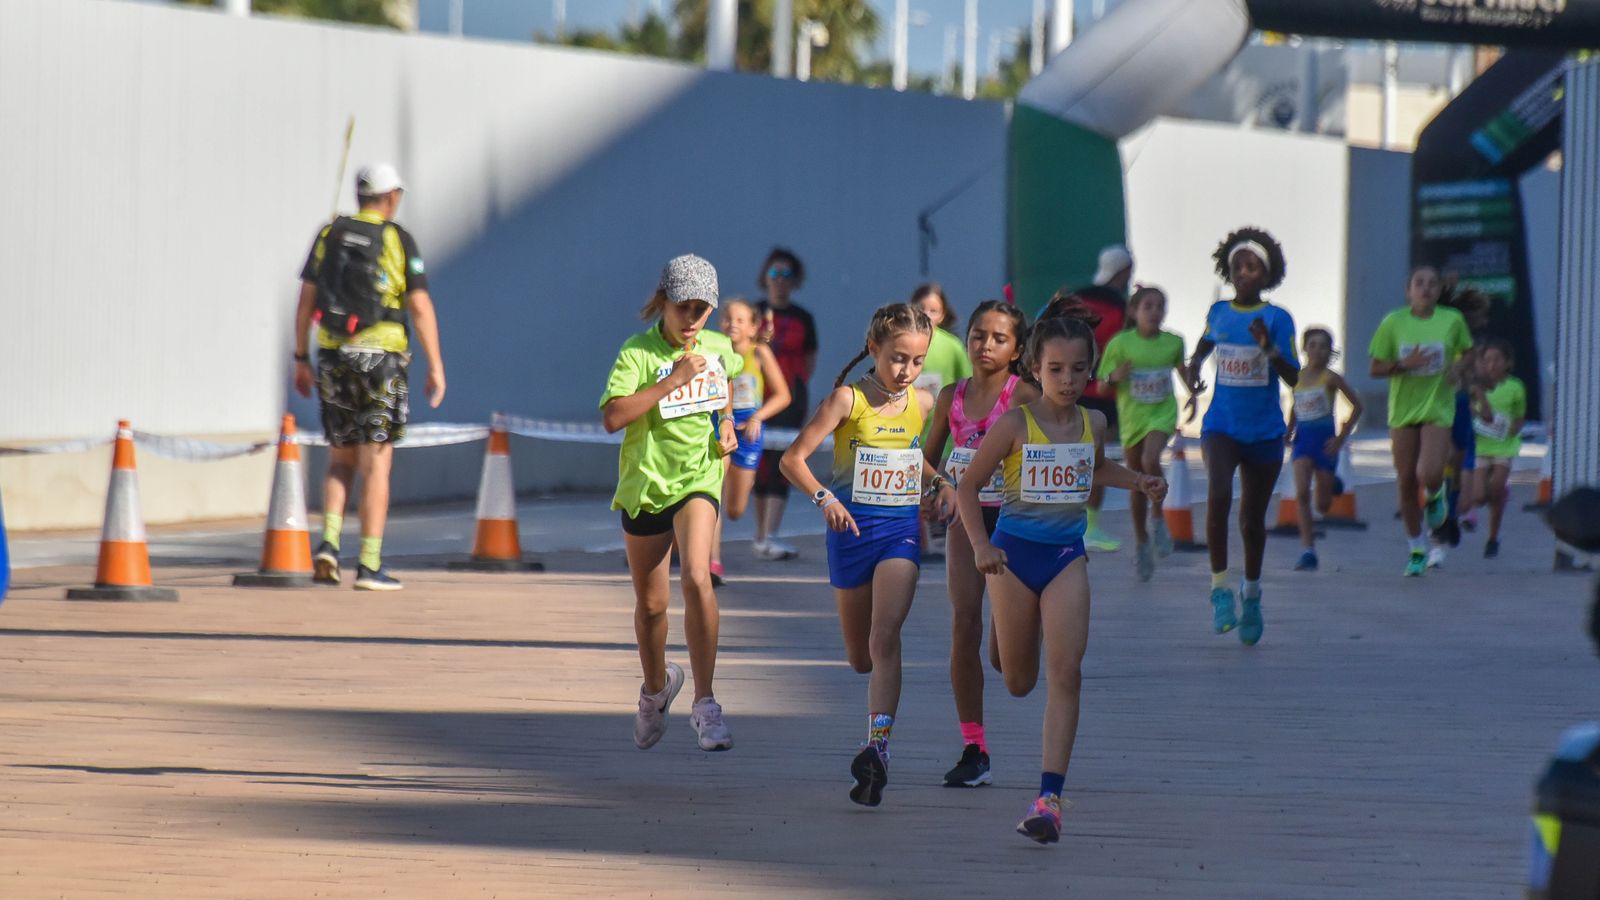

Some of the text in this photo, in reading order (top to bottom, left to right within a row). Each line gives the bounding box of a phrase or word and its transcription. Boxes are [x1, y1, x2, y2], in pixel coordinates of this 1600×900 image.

[859, 452, 874, 462] XXI
[1026, 449, 1041, 459] XXI
[860, 468, 905, 490] 1073
[1028, 465, 1075, 487] 1166
